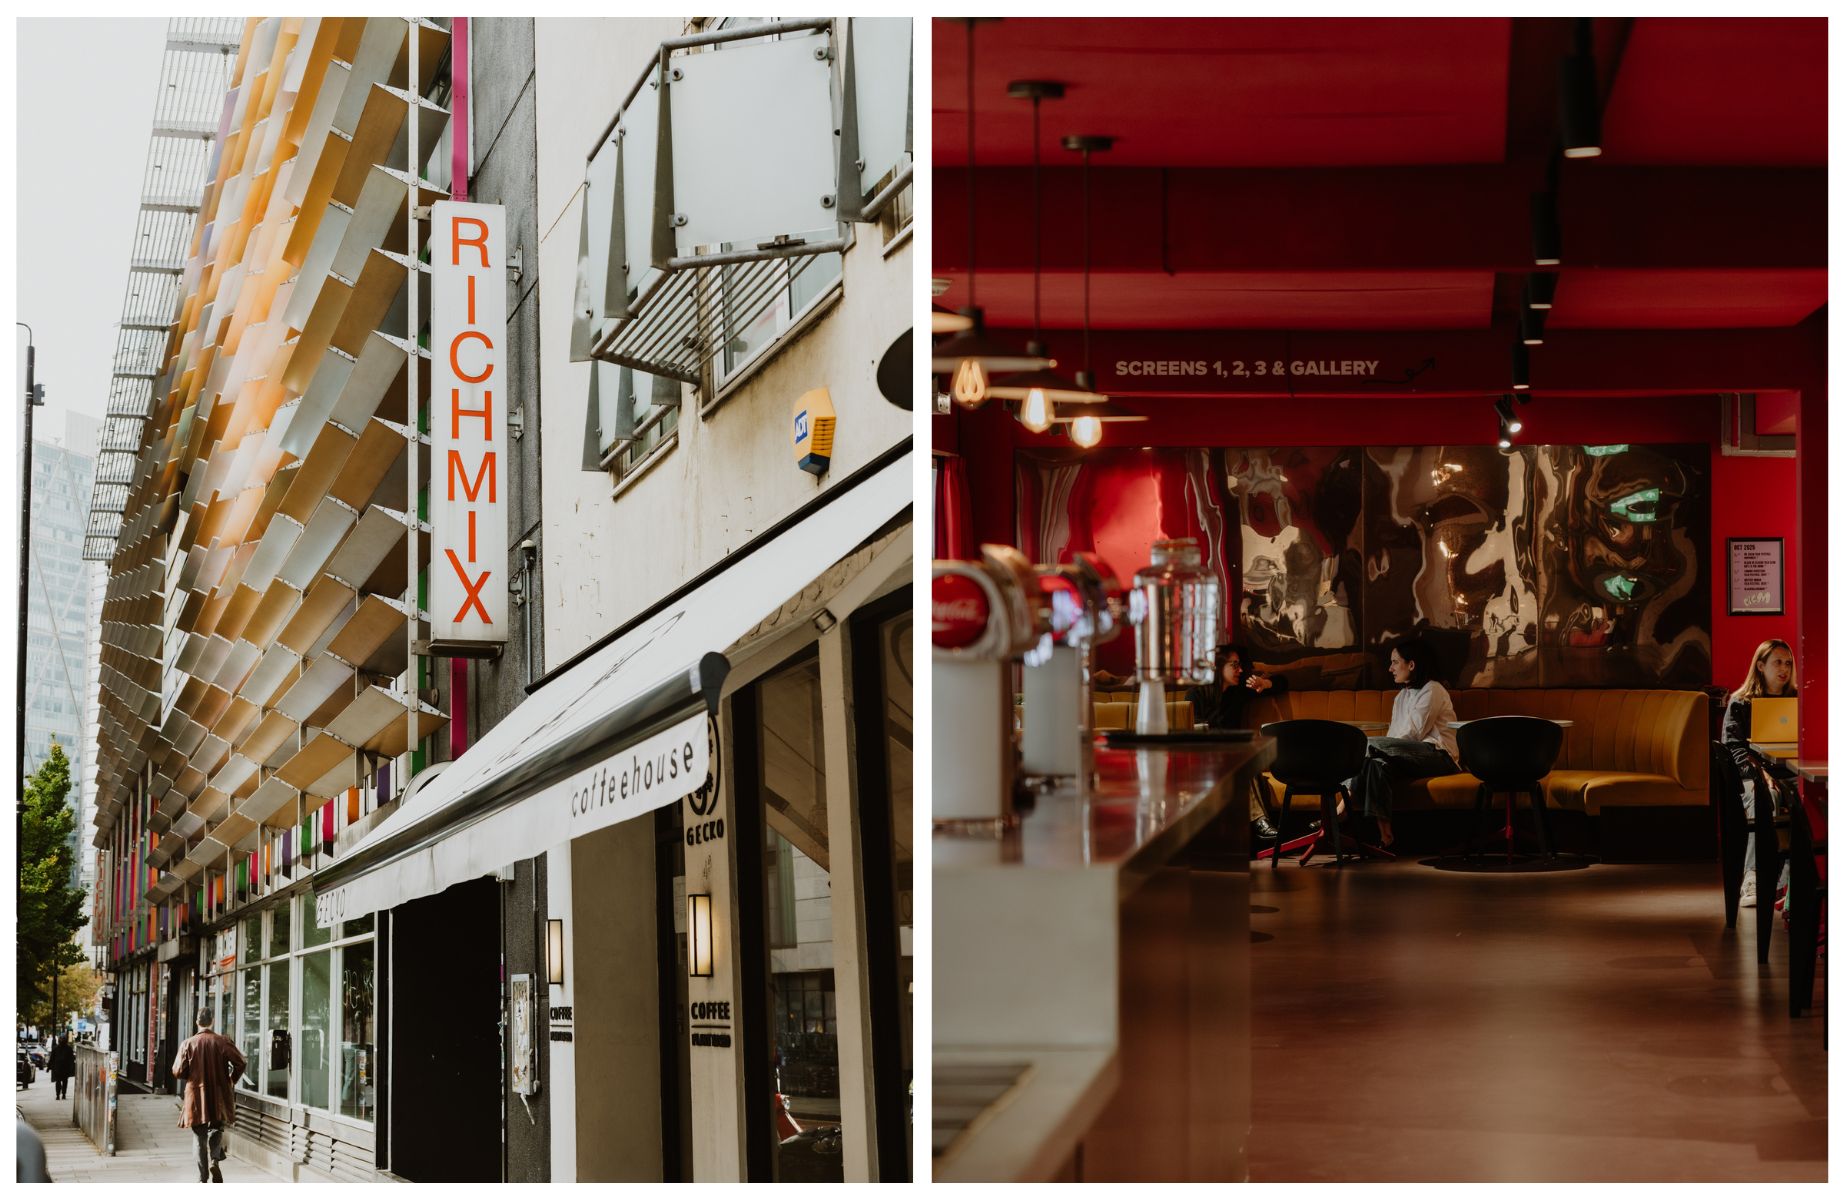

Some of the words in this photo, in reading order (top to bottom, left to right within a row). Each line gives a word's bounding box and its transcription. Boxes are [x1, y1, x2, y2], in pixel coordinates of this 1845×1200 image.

[1115, 360, 1208, 376] SCREENS
[1212, 360, 1228, 378] 1,
[1232, 360, 1251, 378] 2,
[1254, 360, 1267, 376] 3
[1271, 360, 1286, 376] &
[1290, 360, 1380, 376] GALLERY
[444, 216, 497, 625] RICHMIX
[795, 412, 807, 441] ADT
[571, 741, 694, 818] coffeehouse
[686, 818, 725, 847] GECKO
[691, 1001, 731, 1020] COFFEE
